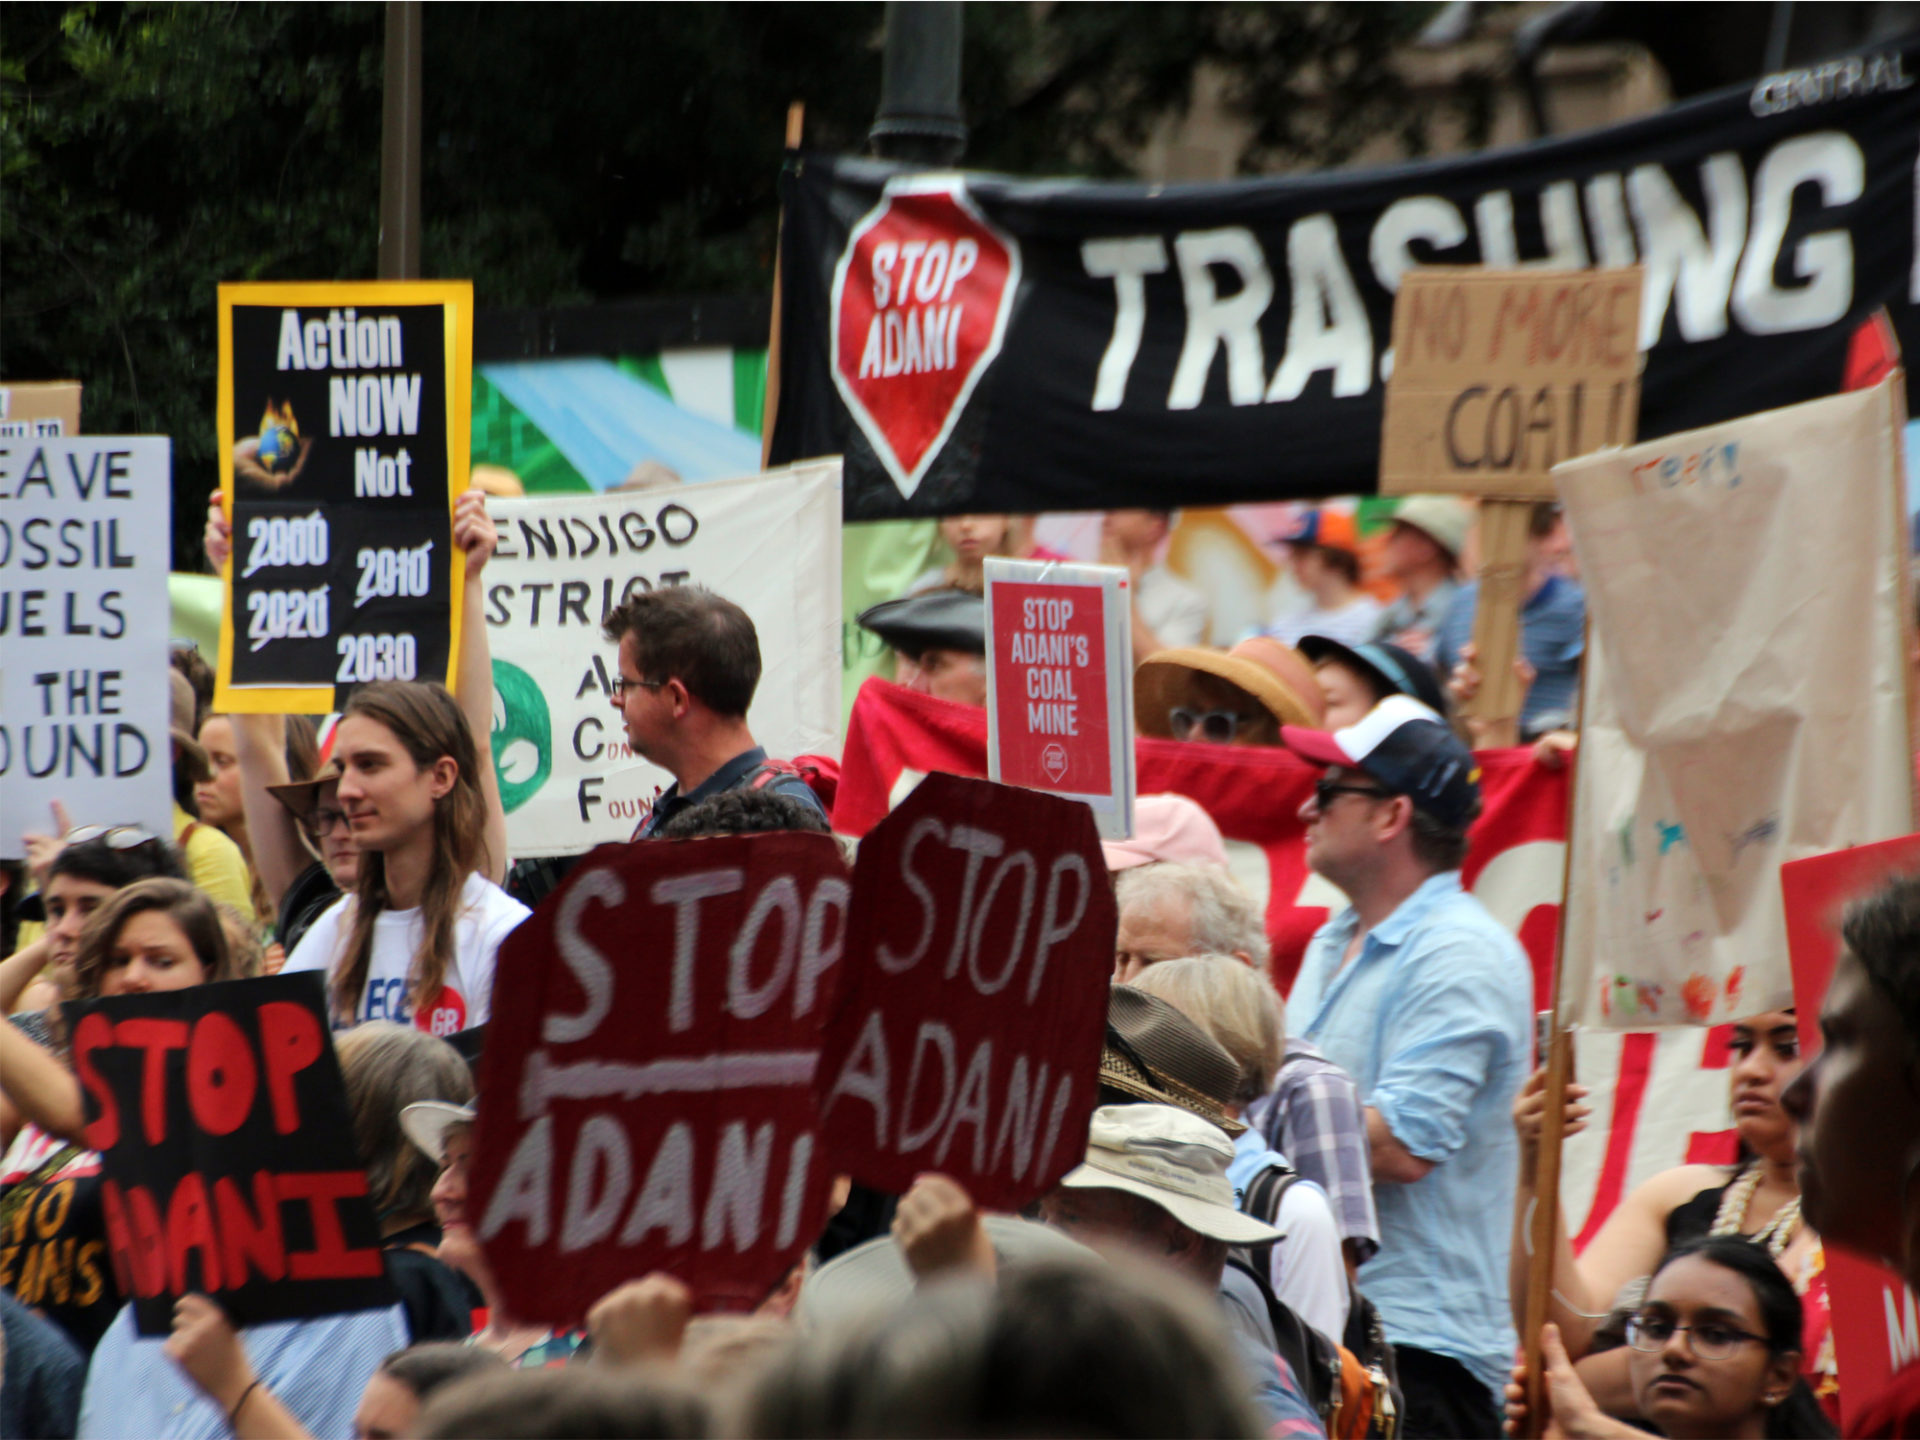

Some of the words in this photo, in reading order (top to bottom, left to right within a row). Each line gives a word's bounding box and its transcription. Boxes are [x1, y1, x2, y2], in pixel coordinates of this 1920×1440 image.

[872, 238, 979, 310] STOP
[277, 308, 402, 371] Action
[860, 303, 963, 379] ADANI
[1402, 285, 1469, 367] NO
[1488, 281, 1634, 368] MORE
[329, 372, 421, 437] NOW
[354, 447, 413, 498] Not
[248, 515, 329, 568] 2000
[357, 546, 430, 598] 2010
[248, 588, 329, 640] 2020
[1023, 597, 1074, 632] STOP
[336, 632, 417, 684] 2030
[1011, 631, 1089, 668] ADANI'S
[34, 669, 121, 716] THE
[1026, 667, 1078, 701] COAL
[1027, 702, 1079, 737] MINE
[876, 816, 1092, 1004] STOP
[542, 867, 851, 1045] STOP
[73, 1001, 324, 1151] STOP
[823, 1010, 1073, 1187] ADANI
[477, 1113, 813, 1254] ADANI
